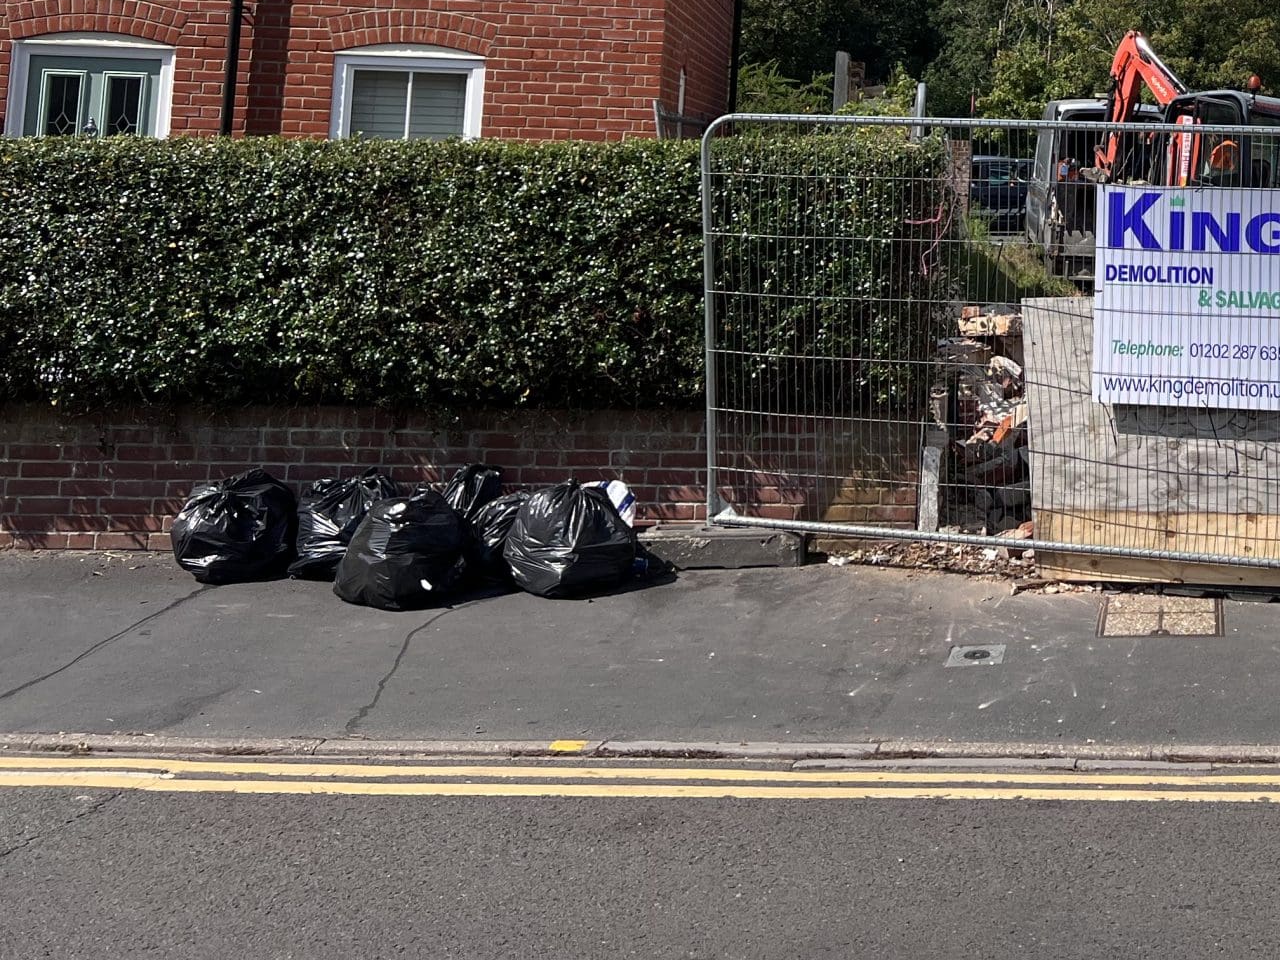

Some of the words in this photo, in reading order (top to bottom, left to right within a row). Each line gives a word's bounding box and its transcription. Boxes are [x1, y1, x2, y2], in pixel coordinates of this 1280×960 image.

[1105, 264, 1214, 285] DEMOLITION
[1198, 289, 1213, 308] &
[1112, 339, 1184, 359] Telephone:
[1190, 342, 1229, 359] 01202
[1232, 344, 1257, 360] 287
